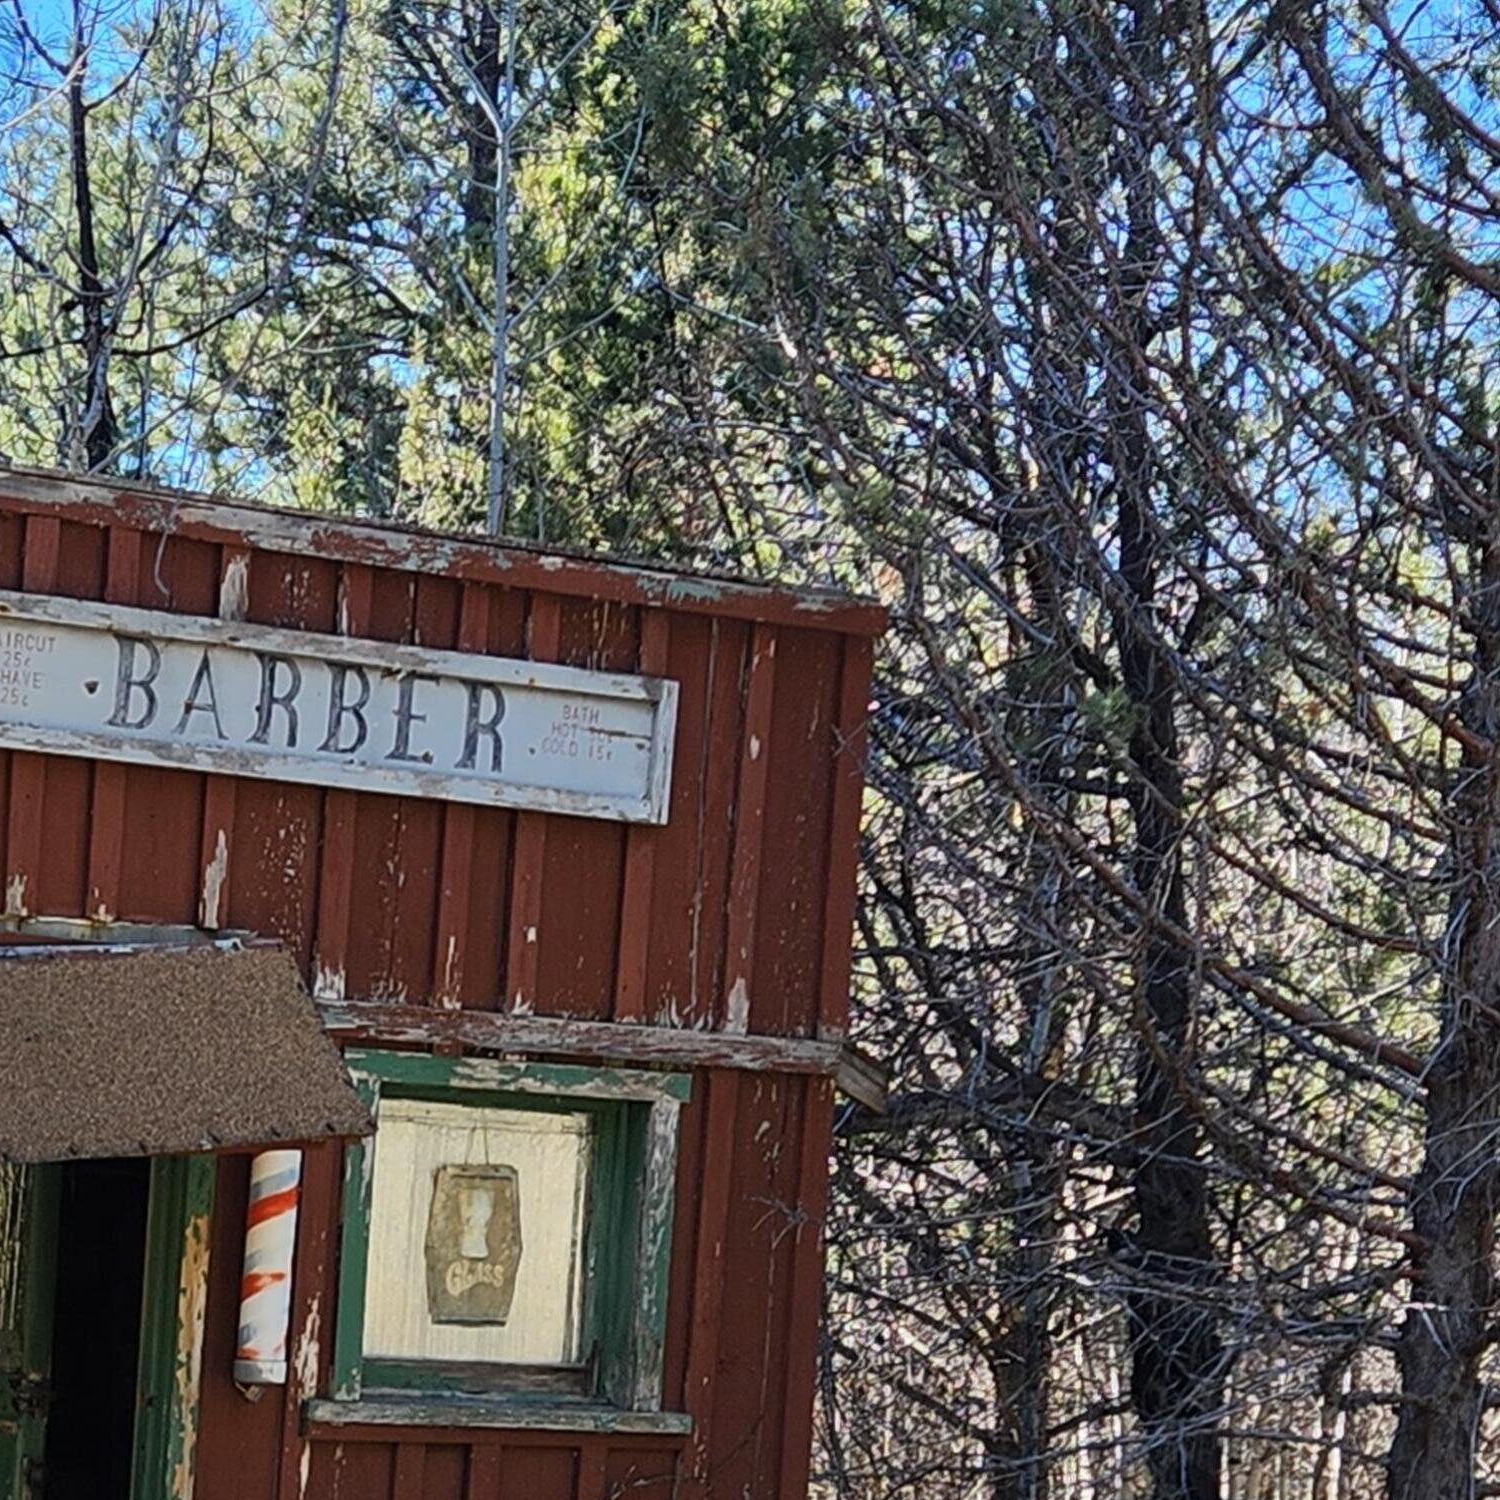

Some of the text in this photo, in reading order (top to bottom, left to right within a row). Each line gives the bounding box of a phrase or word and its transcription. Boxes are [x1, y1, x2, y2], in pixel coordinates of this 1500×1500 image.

[104, 632, 507, 773] BARBER
[562, 704, 600, 724] BATH
[551, 722, 578, 738] HOT
[541, 736, 579, 758] COLD
